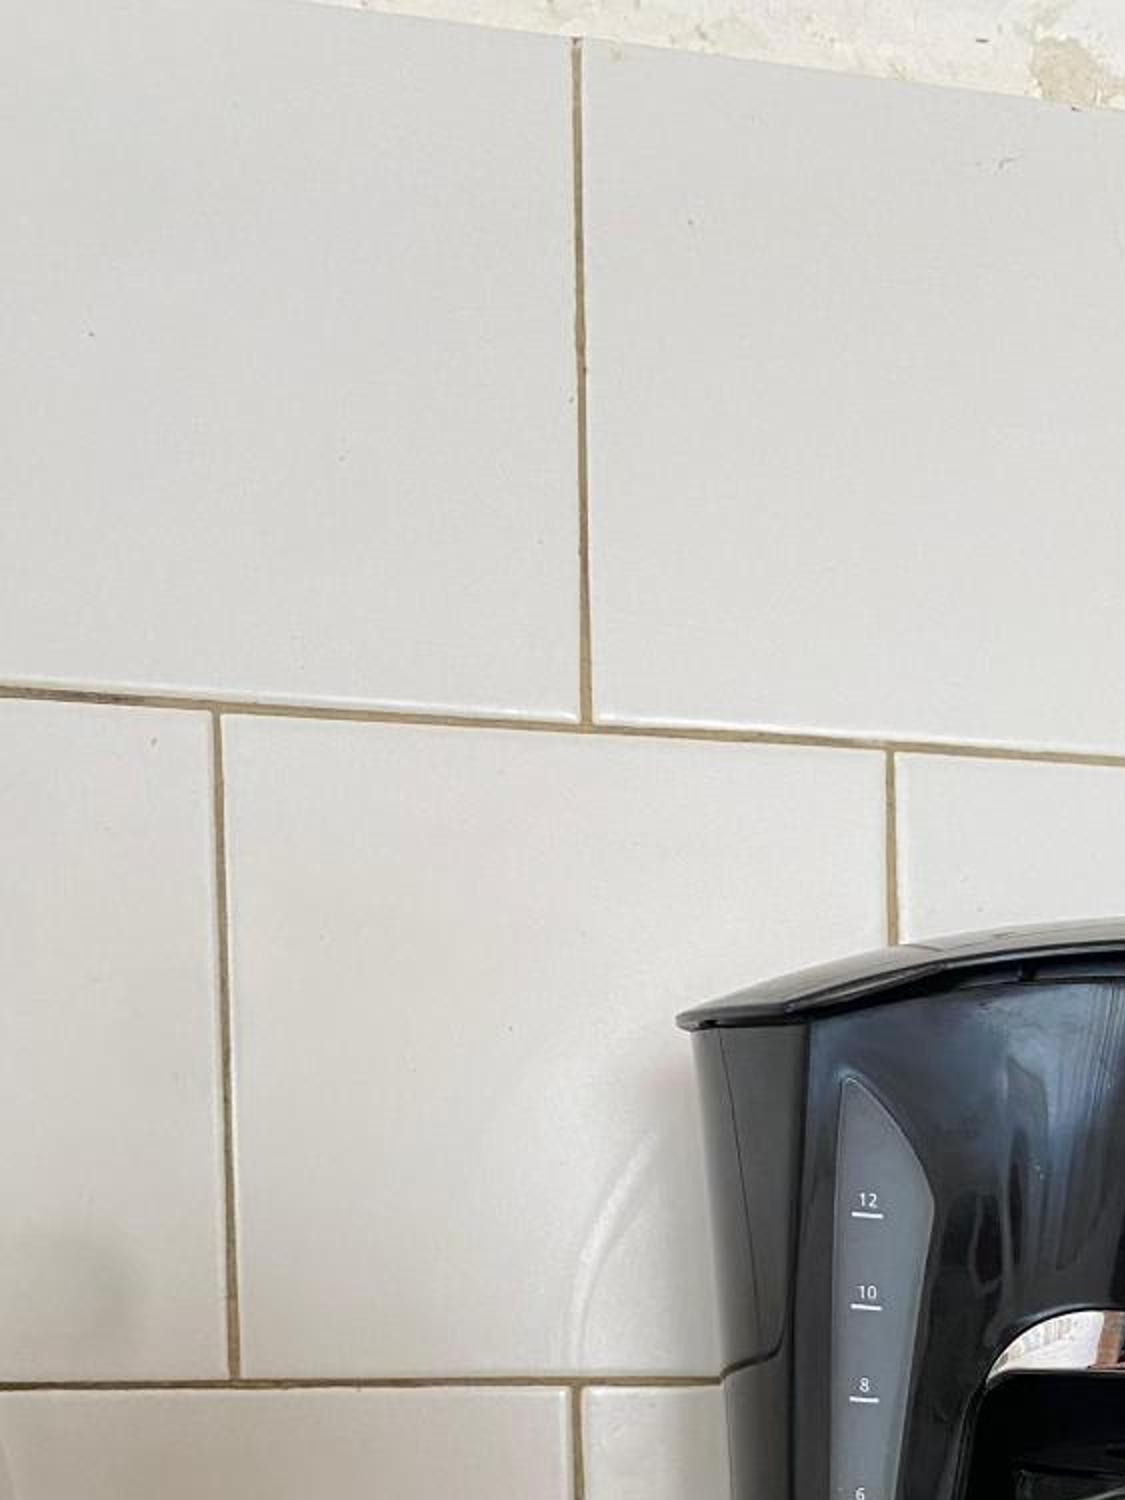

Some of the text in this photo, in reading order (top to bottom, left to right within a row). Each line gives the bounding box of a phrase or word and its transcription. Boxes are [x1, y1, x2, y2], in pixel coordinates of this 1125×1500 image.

[858, 1192, 878, 1209] 12
[857, 1285, 877, 1300] 10
[859, 1377, 869, 1393] 8
